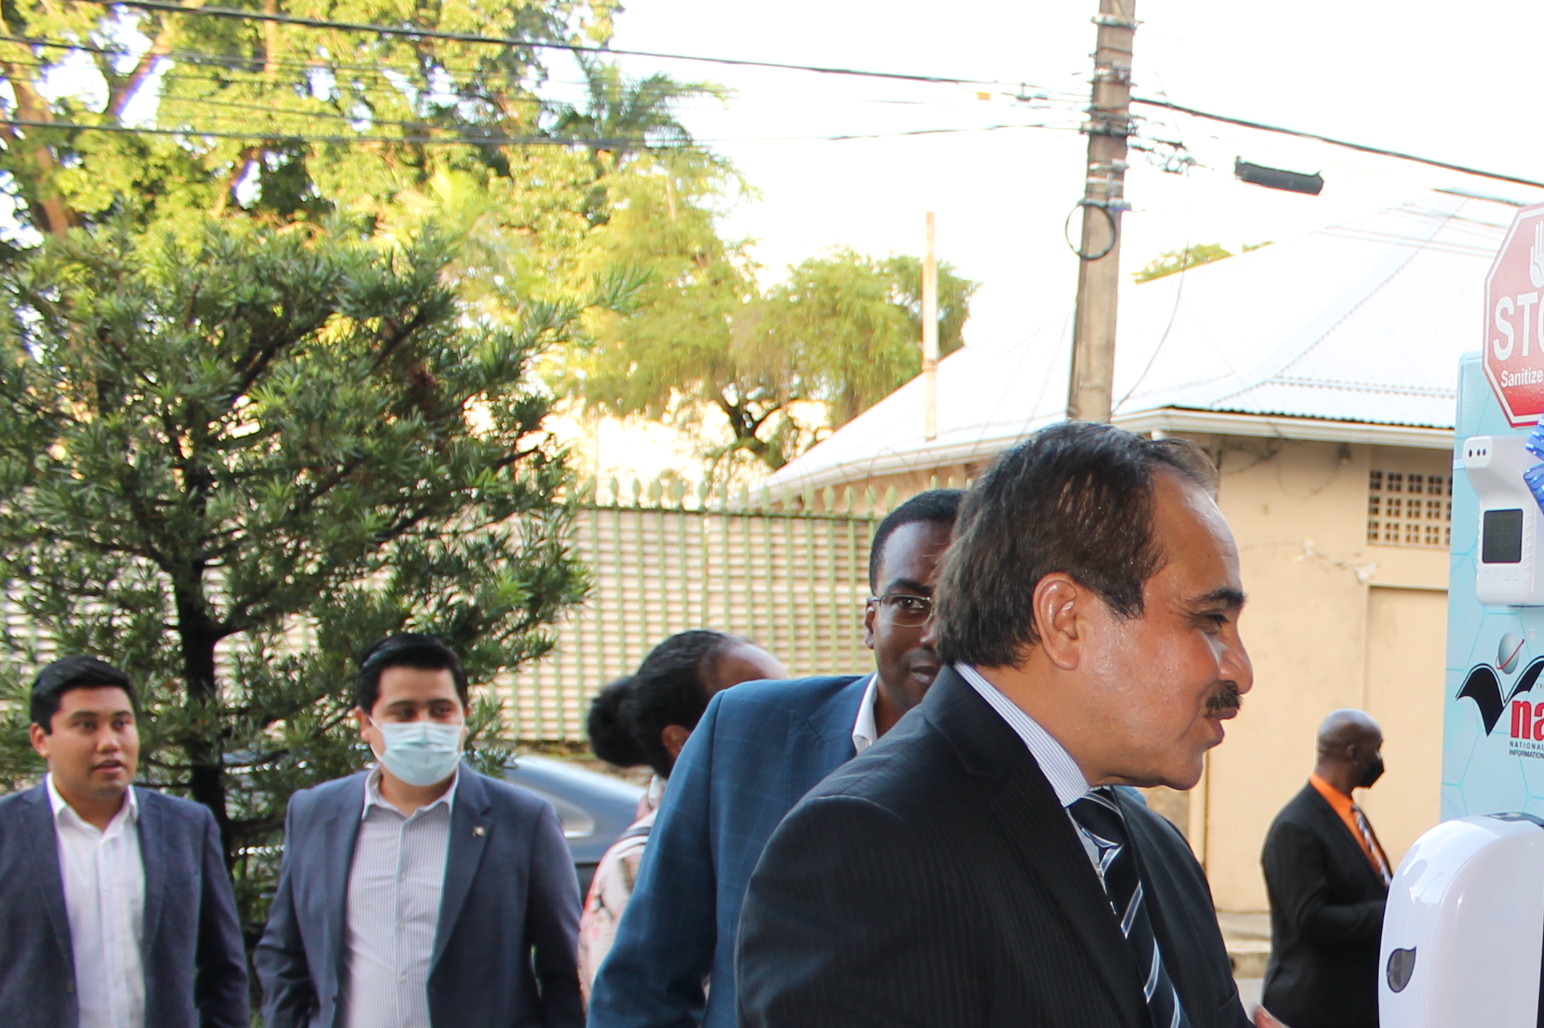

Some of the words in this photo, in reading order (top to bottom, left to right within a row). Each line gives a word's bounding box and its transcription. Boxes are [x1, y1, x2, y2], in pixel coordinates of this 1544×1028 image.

[1501, 367, 1543, 388] Sanitize
[1509, 740, 1544, 751] NATIONAL
[1509, 749, 1544, 759] INFORMATION
